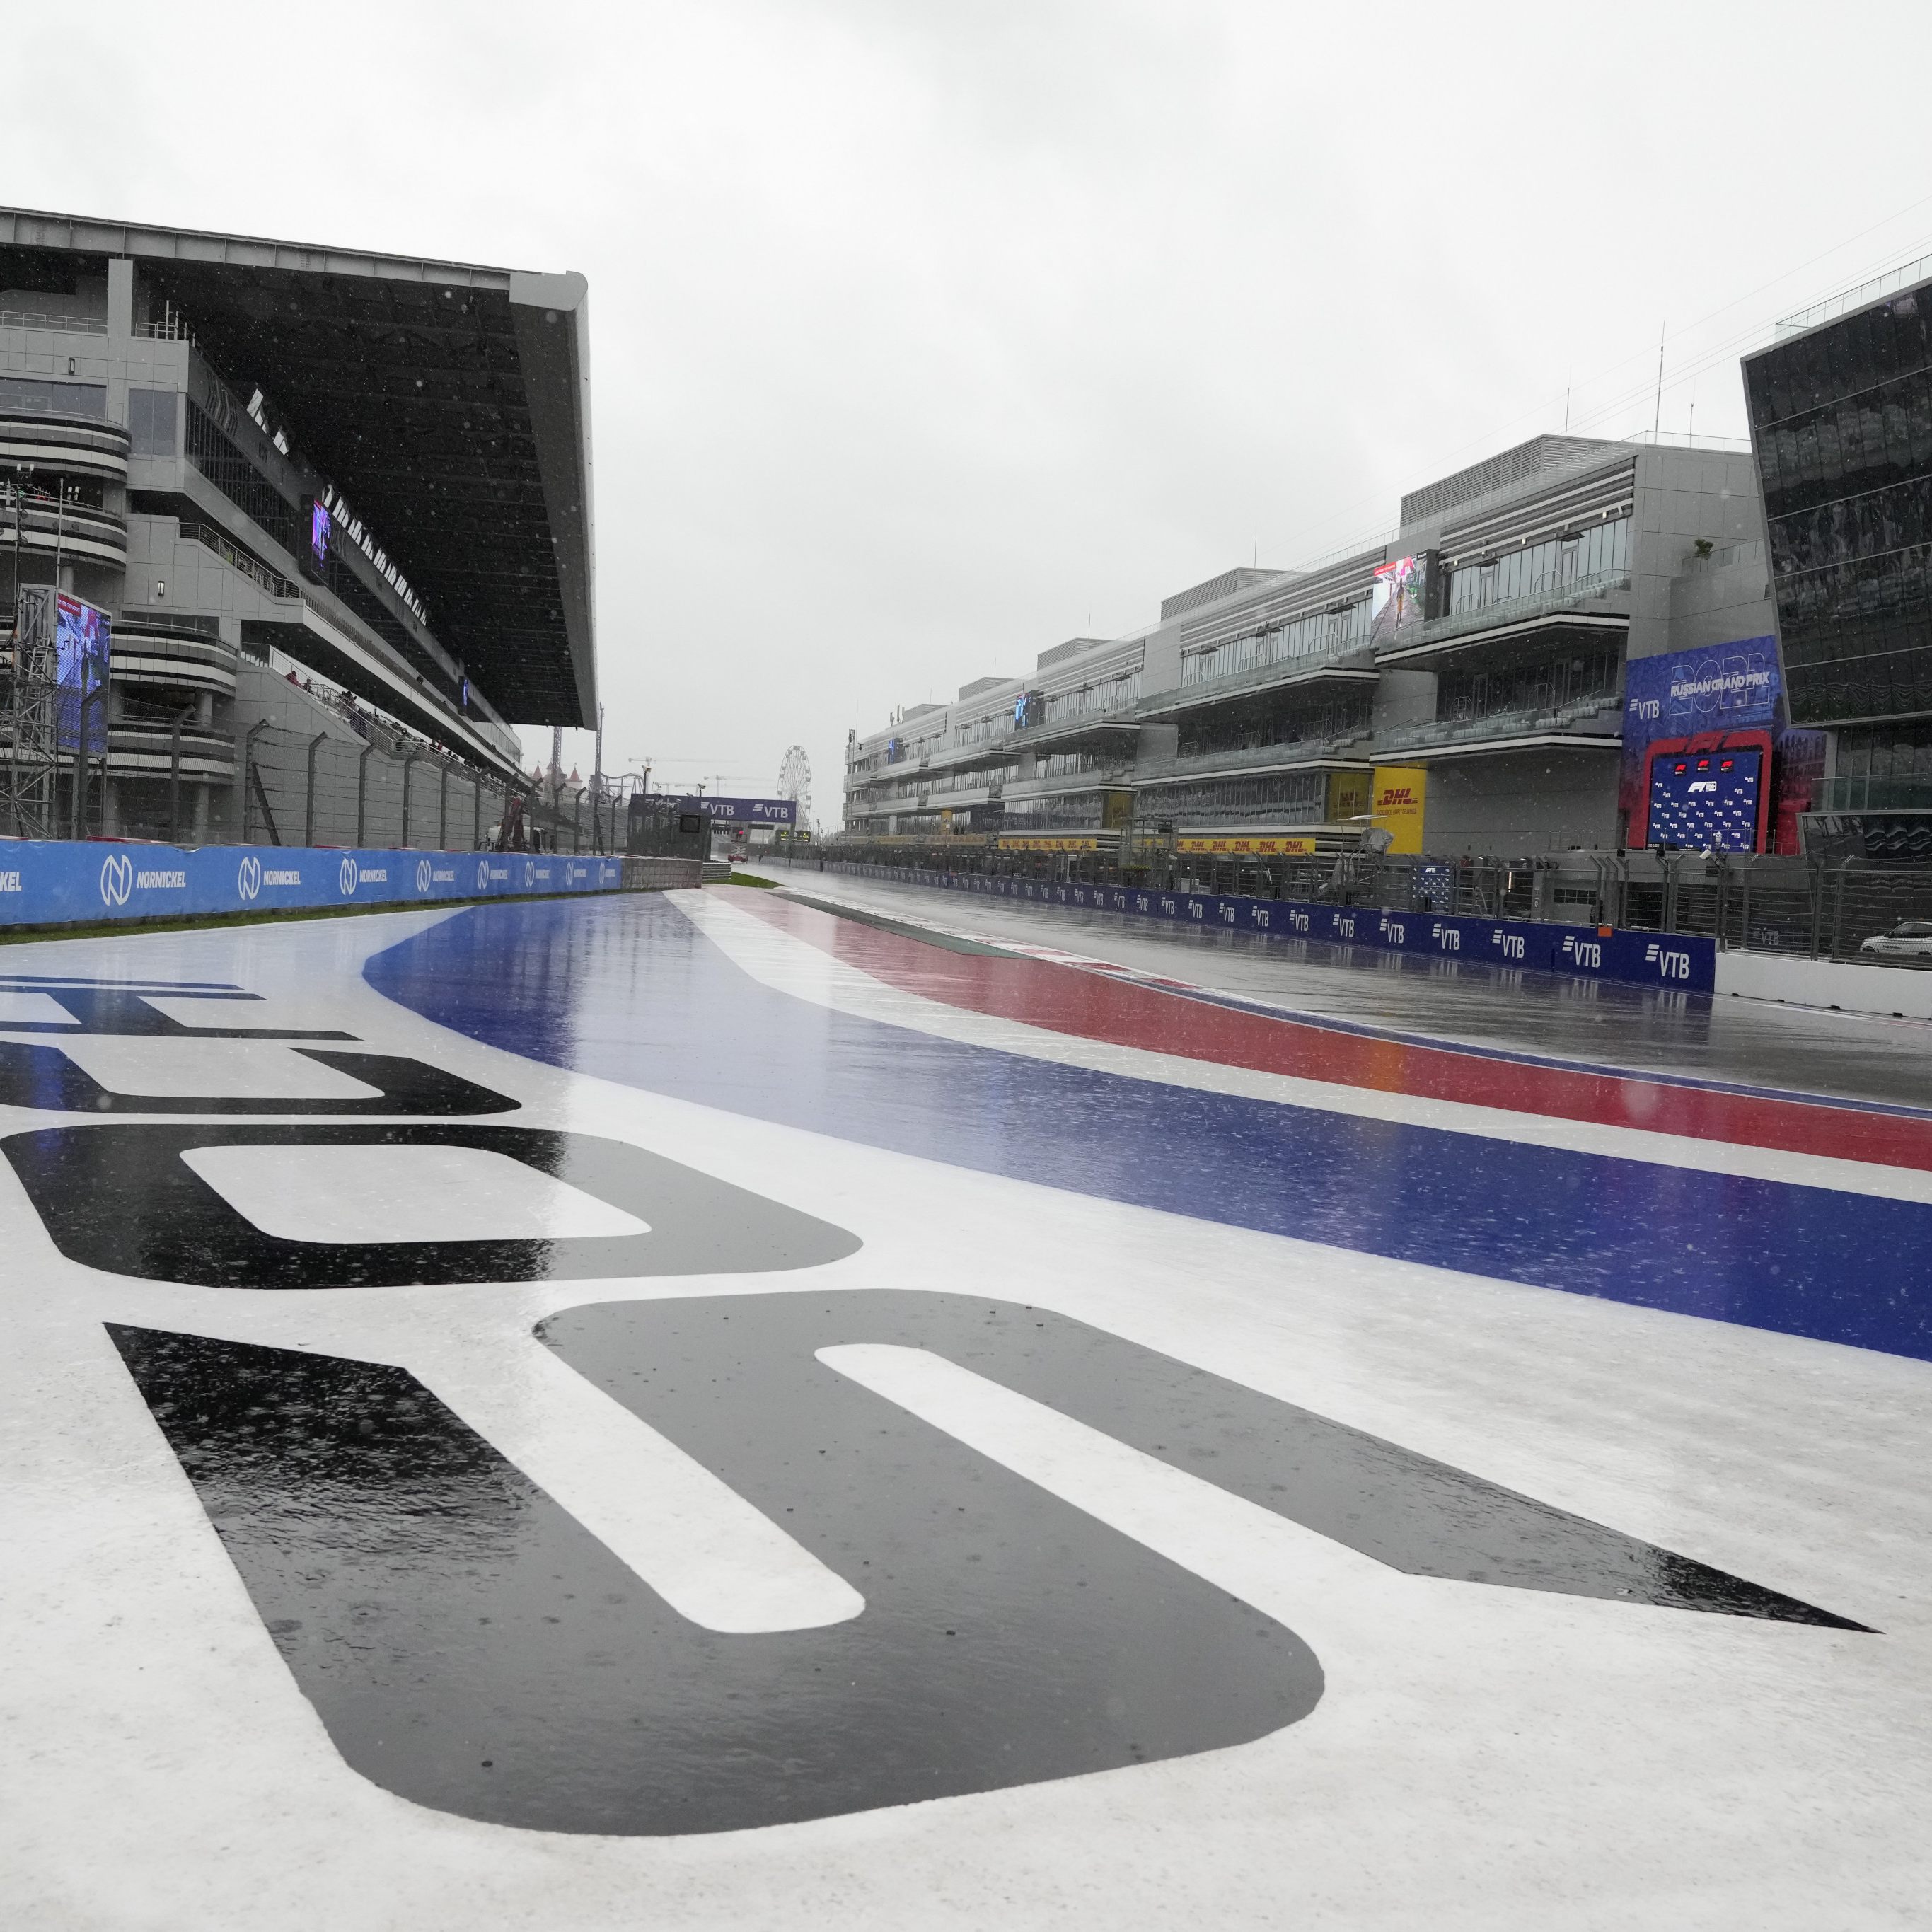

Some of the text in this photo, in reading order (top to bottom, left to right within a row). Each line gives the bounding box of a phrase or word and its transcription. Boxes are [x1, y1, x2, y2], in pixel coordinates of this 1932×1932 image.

[1670, 671, 1770, 697] RUSSIAN GRAND PRIX
[1638, 700, 1660, 719] VTB
[1382, 788, 1412, 805] DHL
[710, 804, 734, 816] VTB
[764, 806, 788, 818] VTB
[1191, 841, 1205, 851] DHL
[1212, 841, 1227, 851] DHL
[1234, 841, 1250, 851] DHL
[1259, 841, 1276, 852] DHL
[1285, 841, 1305, 852] DHL
[0, 871, 22, 891] KEL
[137, 871, 186, 889] NORNICKEL
[263, 870, 301, 886] NORNICKEL
[359, 869, 387, 883] NORNICKEL
[1139, 898, 1148, 912] VTB
[1165, 901, 1174, 915] VTB
[1193, 903, 1203, 918] VTB
[1224, 907, 1234, 922] VTB
[1257, 910, 1269, 927] VTB
[1295, 914, 1309, 932] VTB
[1339, 919, 1355, 938] VTB
[1387, 923, 1404, 944] VTB
[1441, 928, 1460, 951] VTB
[1502, 935, 1525, 959] VTB
[1575, 942, 1601, 968] VTB
[1660, 951, 1689, 979] VTB
